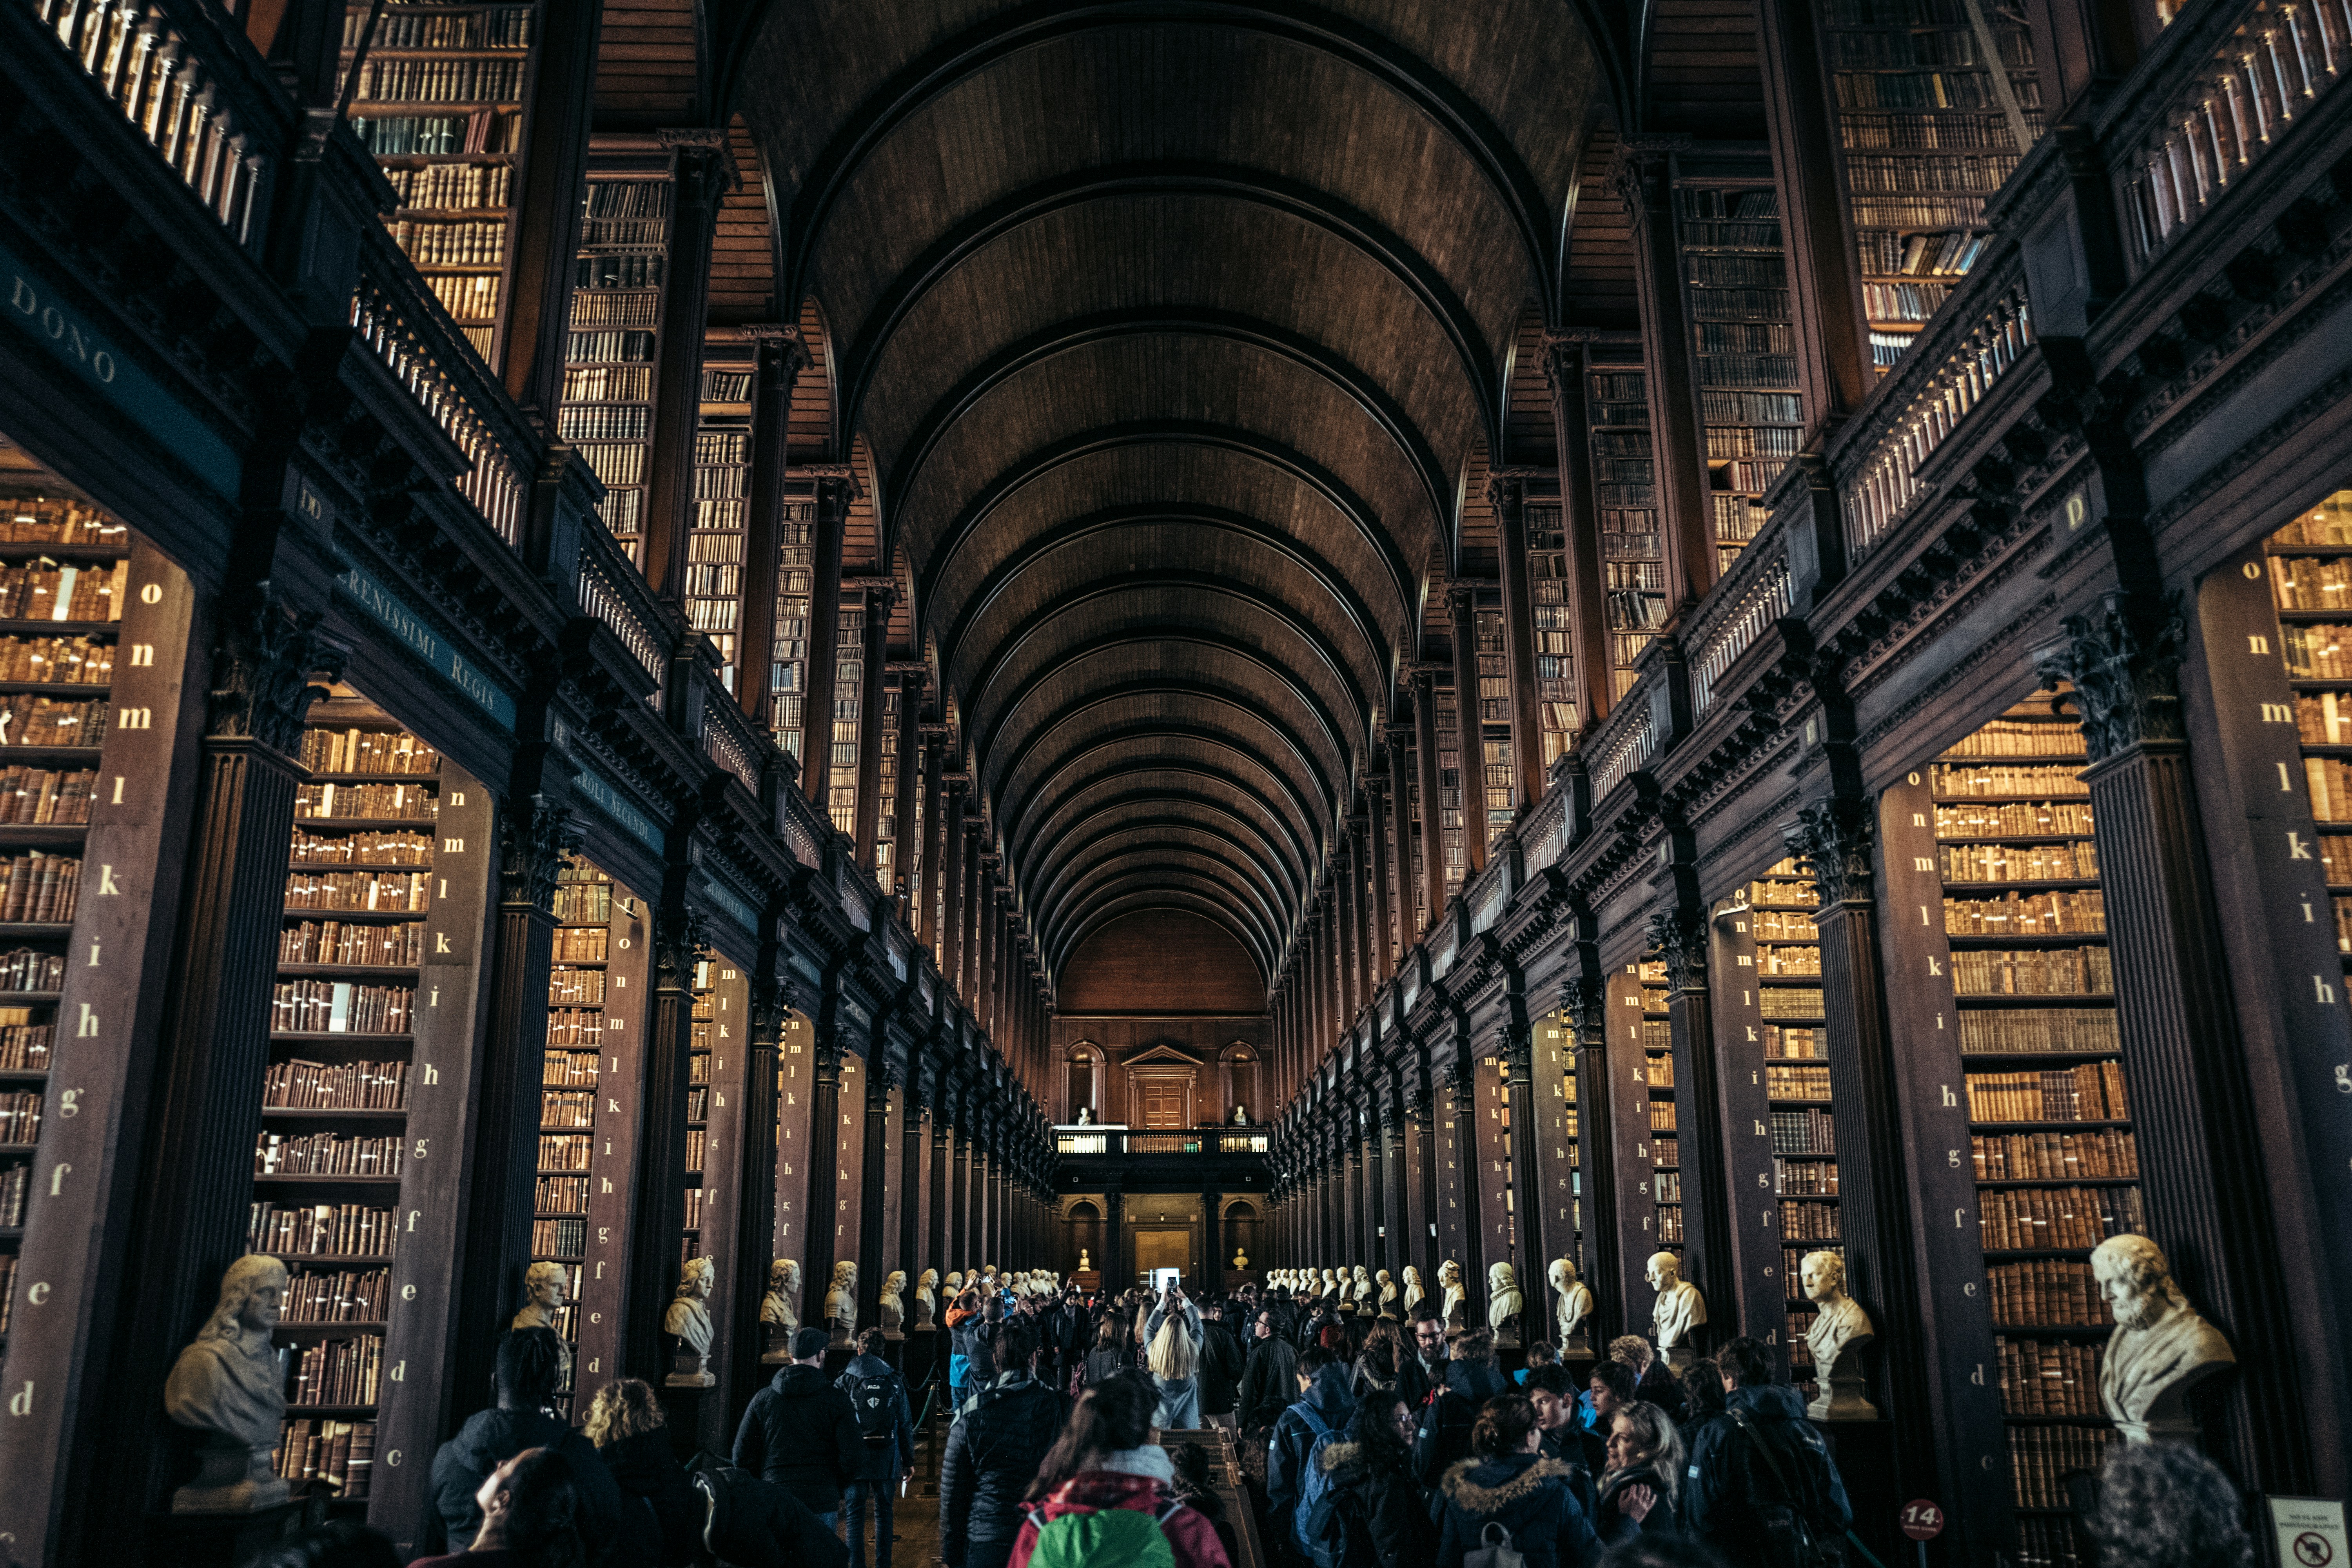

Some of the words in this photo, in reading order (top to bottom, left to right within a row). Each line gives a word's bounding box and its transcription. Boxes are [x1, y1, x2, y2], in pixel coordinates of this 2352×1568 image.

[11, 275, 116, 383] DONO
[2243, 563, 2260, 579] o
[141, 584, 162, 604] o
[2249, 635, 2269, 654] n
[131, 644, 154, 666] n
[451, 653, 494, 710] REGIS
[119, 707, 151, 729] m
[2261, 703, 2292, 722] m
[1908, 772, 1920, 786] o
[450, 792, 465, 806] n
[1913, 813, 1926, 827] n
[444, 838, 464, 853] m
[2288, 831, 2311, 859] k
[1914, 857, 1934, 871] m
[98, 864, 118, 895] k
[1735, 889, 1745, 899] o
[2301, 893, 2314, 922] i
[1735, 921, 1747, 932] n
[436, 932, 450, 953] k
[619, 938, 630, 949] o
[88, 936, 100, 966] i
[1737, 955, 1752, 966] m
[1928, 956, 1942, 976] k
[722, 969, 736, 980] m
[1627, 965, 1636, 974] n
[616, 976, 626, 987] n
[430, 985, 439, 1007] i
[2314, 975, 2335, 1004] h
[1625, 996, 1639, 1006] m
[78, 1003, 98, 1037] h
[610, 1018, 624, 1030] m
[791, 1021, 799, 1029] n
[1936, 1013, 1943, 1029] i
[719, 1024, 729, 1038] k
[1547, 1030, 1559, 1038] m
[1746, 1026, 1757, 1041] k
[718, 1056, 723, 1070] i
[1485, 1057, 1497, 1066] m
[423, 1063, 438, 1085] h
[1633, 1068, 1643, 1081] k
[1751, 1071, 1758, 1084] i
[2334, 1064, 2352, 1093] g
[1553, 1084, 1562, 1096] k
[1941, 1085, 1957, 1107] h
[60, 1088, 83, 1116] g
[608, 1099, 621, 1112] k
[715, 1092, 725, 1107] h
[788, 1093, 795, 1104] k
[1636, 1100, 1641, 1112] i
[843, 1114, 851, 1124] k
[1491, 1109, 1498, 1119] k
[1556, 1116, 1560, 1127] i
[1754, 1120, 1766, 1135] h
[786, 1129, 790, 1138] i
[1494, 1133, 1498, 1143] i
[414, 1139, 429, 1158] g
[604, 1138, 612, 1155] i
[711, 1139, 719, 1151] g
[842, 1140, 846, 1150] i
[1638, 1143, 1647, 1157] h
[1557, 1147, 1564, 1158] h
[1949, 1149, 1961, 1168] g
[784, 1162, 792, 1175] h
[1494, 1160, 1501, 1171] h
[50, 1163, 71, 1196] f
[840, 1170, 848, 1180] h
[1759, 1173, 1769, 1188] g
[602, 1177, 612, 1193] h
[1559, 1178, 1566, 1189] g
[1639, 1182, 1647, 1194] g
[709, 1189, 717, 1204] f
[1450, 1198, 1455, 1208] h
[1496, 1192, 1502, 1201] g
[783, 1201, 790, 1211] g
[839, 1200, 847, 1210] g
[1560, 1208, 1566, 1219] f
[1762, 1210, 1771, 1227] f
[1955, 1208, 1965, 1228] f
[407, 1210, 421, 1232] f
[1643, 1216, 1650, 1230] f
[598, 1227, 610, 1244] g
[783, 1223, 789, 1236] f
[838, 1225, 844, 1236] f
[1497, 1224, 1503, 1233] f
[595, 1261, 606, 1279] f
[1764, 1267, 1773, 1276] e
[28, 1282, 49, 1305] e
[401, 1285, 416, 1300] e
[1964, 1283, 1976, 1296] e
[590, 1312, 601, 1323] e
[1766, 1329, 1777, 1345] d
[390, 1360, 405, 1381] d
[588, 1357, 599, 1373] d
[1971, 1363, 1984, 1385] d
[9, 1381, 33, 1416] d
[387, 1449, 401, 1466] c
[1981, 1455, 1993, 1470] c
[1906, 1506, 1936, 1525] 14
